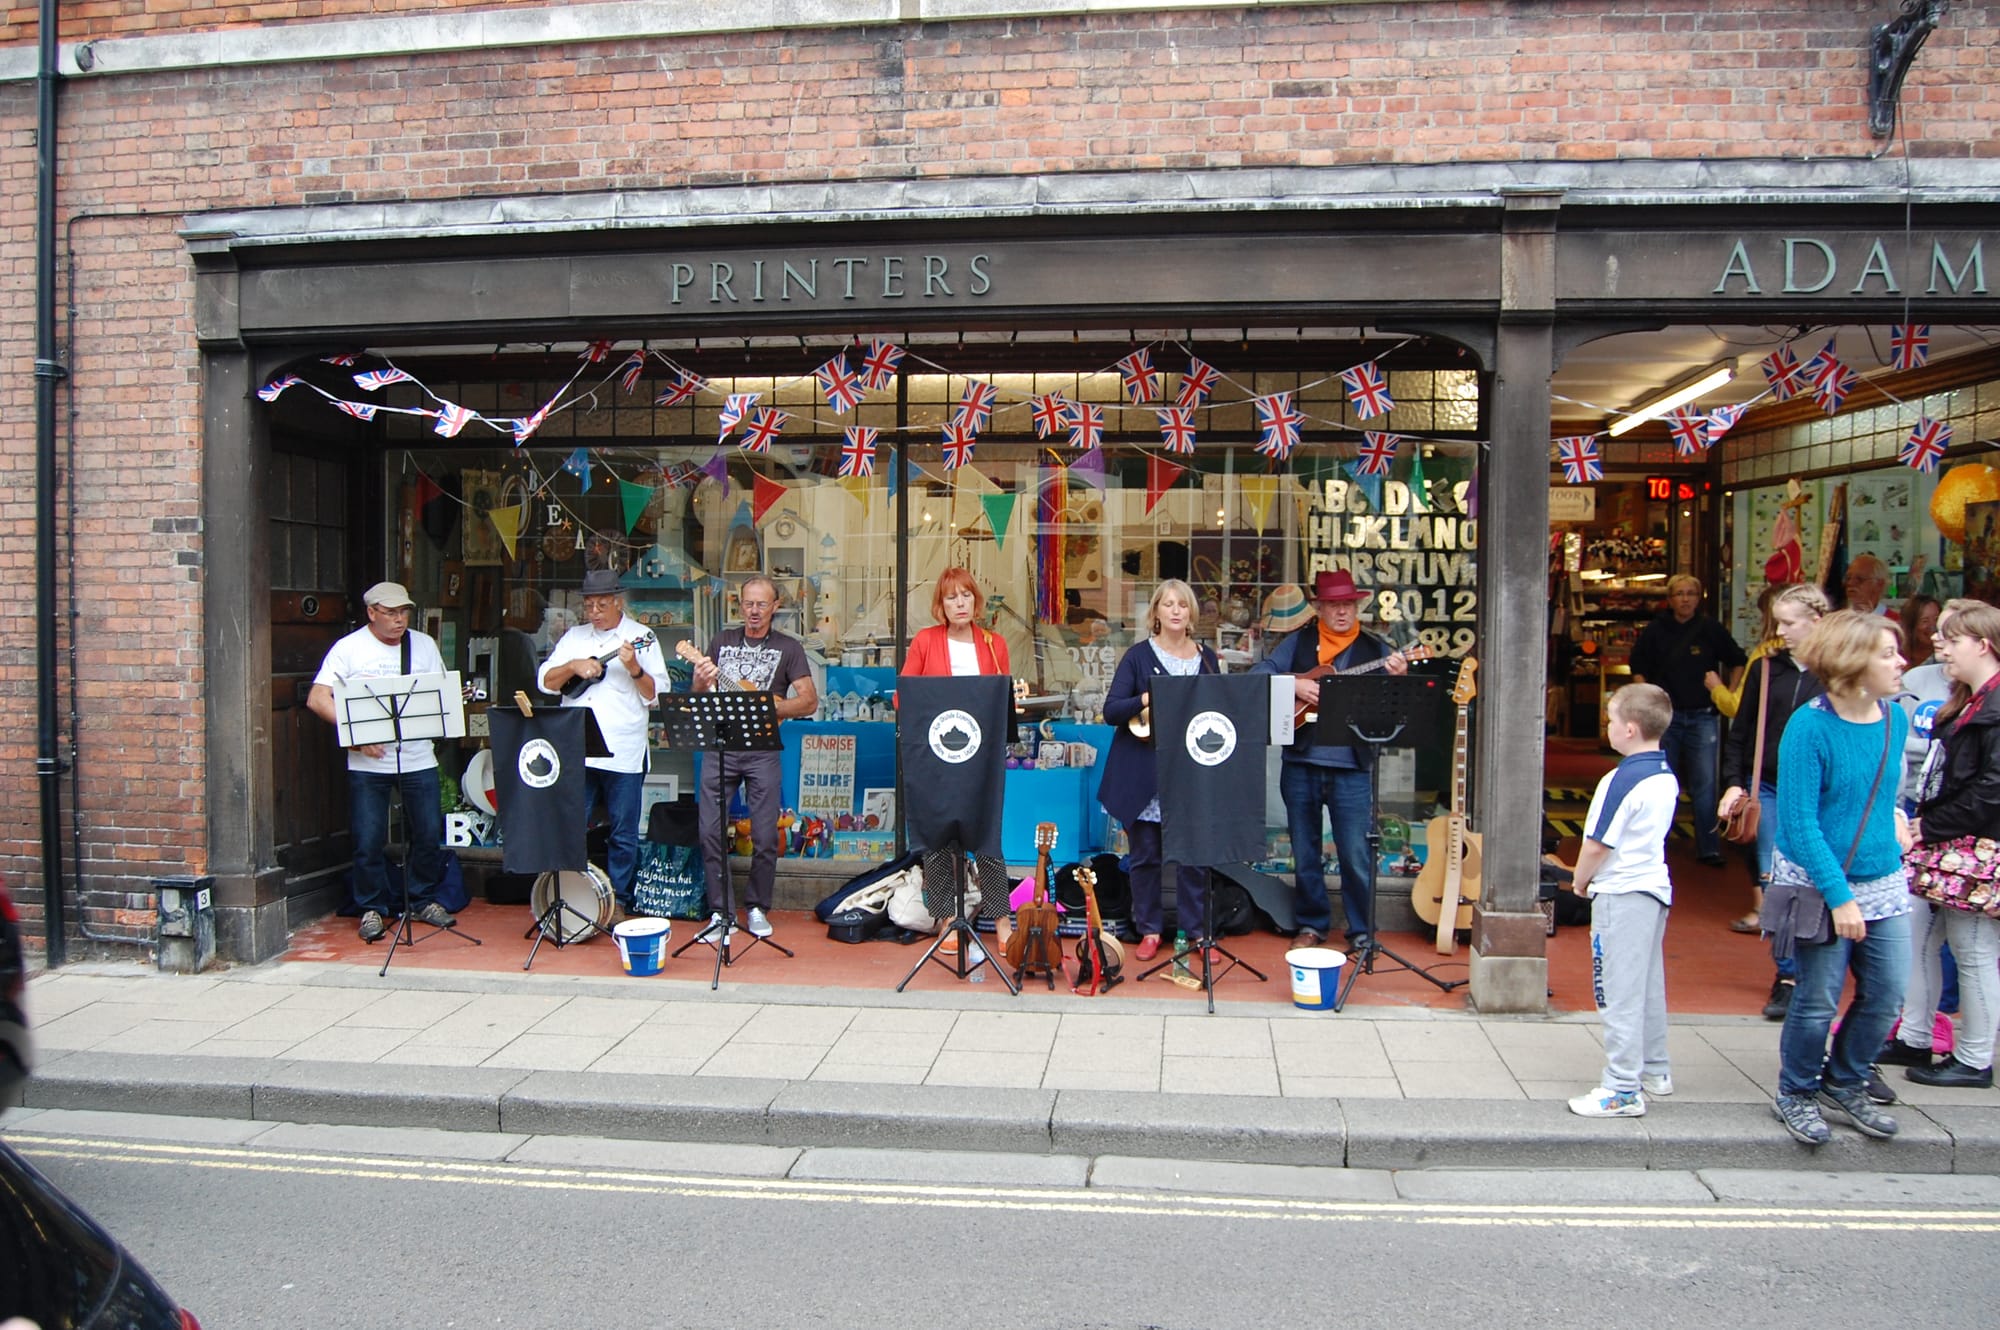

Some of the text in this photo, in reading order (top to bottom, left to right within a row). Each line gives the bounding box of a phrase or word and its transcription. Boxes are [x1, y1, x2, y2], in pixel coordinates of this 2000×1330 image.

[1712, 238, 1987, 294] ADAM
[671, 254, 991, 304] PRINTERS
[804, 738, 854, 751] SUNRISE
[803, 773, 853, 787] SURF
[801, 795, 850, 809] BEACH
[201, 892, 208, 905] 3
